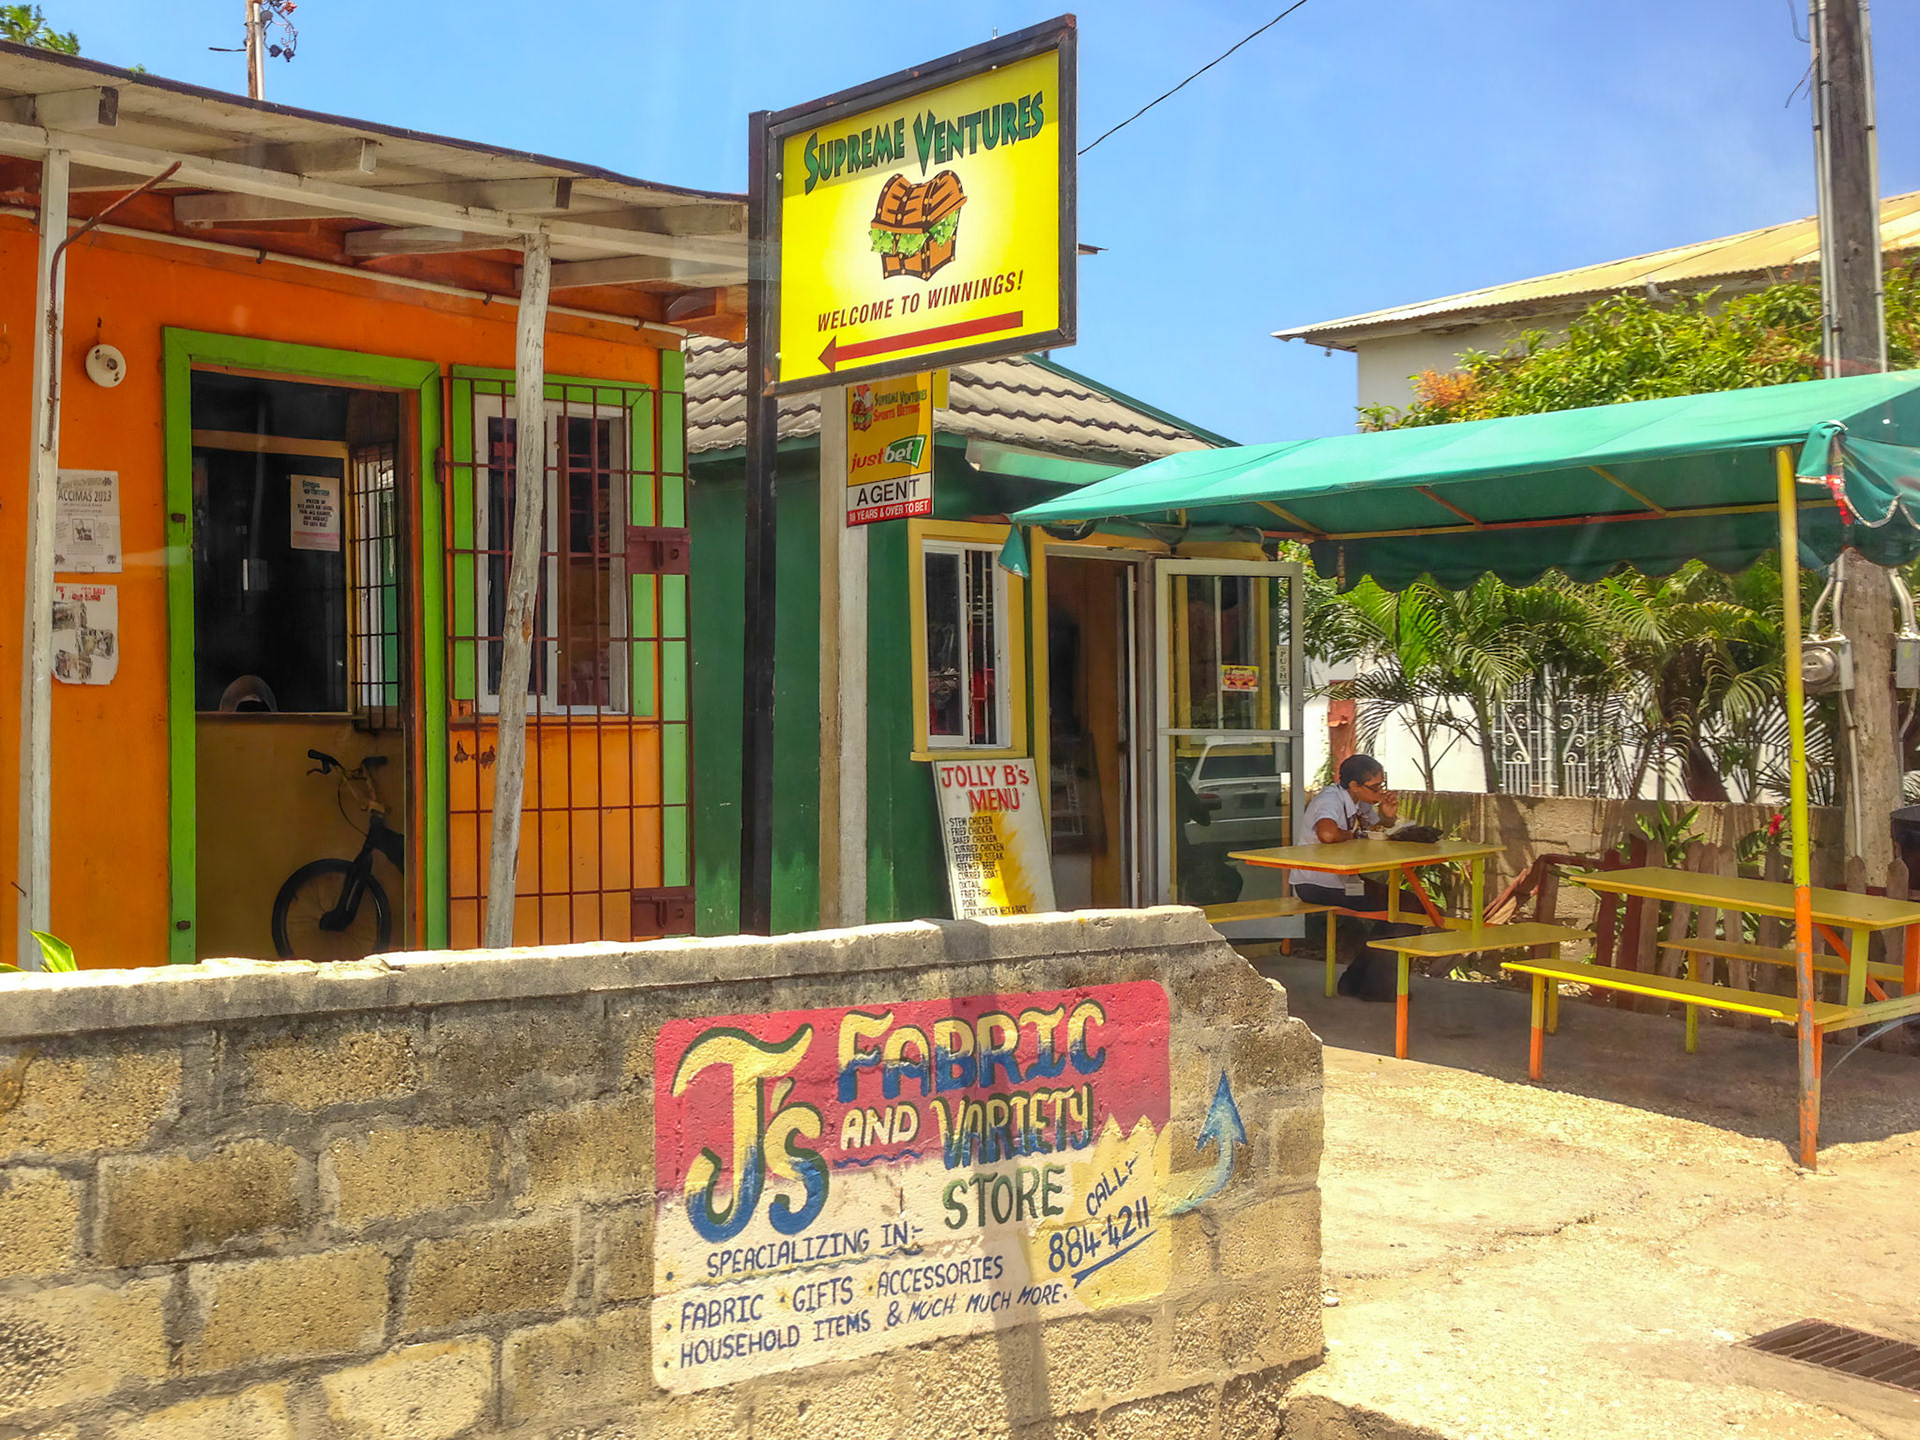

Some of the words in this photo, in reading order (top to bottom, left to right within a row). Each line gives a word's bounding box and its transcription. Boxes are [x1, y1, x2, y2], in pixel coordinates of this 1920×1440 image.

[803, 117, 905, 196] SUPREME
[912, 90, 1044, 177] VENTURES
[817, 298, 894, 332] WELCOME
[901, 293, 920, 316] TO
[927, 269, 1024, 309] WINNINGS!
[94, 489, 112, 502] 2013
[856, 478, 920, 507] AGENT
[857, 508, 878, 520] YEARS
[880, 507, 885, 518] &
[885, 504, 904, 517] OVER
[904, 502, 914, 514] TO
[915, 500, 929, 512] BET
[1279, 650, 1287, 679] PUSH
[941, 765, 996, 788] JOLLY
[967, 787, 1020, 812] MENU
[949, 817, 967, 827] STEW
[968, 816, 993, 826] CHICKEN
[951, 827, 966, 836] FRIED
[968, 825, 994, 835] CHICKEN
[952, 836, 970, 845] BAKED
[972, 834, 998, 844] CHICKEN
[954, 844, 978, 854] CURRIED
[980, 842, 1005, 852] CHICKEN
[956, 862, 980, 872] STEWED
[982, 861, 995, 870] BEEF
[984, 852, 1004, 861] STEAK
[959, 880, 980, 889] OXTAIL
[983, 870, 999, 879] GOAT
[961, 889, 976, 898] FRIED
[978, 889, 991, 898] FISH
[962, 899, 977, 908] PORK
[837, 998, 1107, 1104] FABRIC
[840, 1101, 921, 1150] AND
[929, 1081, 1094, 1171] VARIETY
[942, 1161, 1066, 1230] STORE
[1049, 1195, 1151, 1273] 884-4211
[706, 1228, 870, 1278] SPEACIALIZING
[680, 1293, 764, 1333] FABRIC
[792, 1275, 854, 1313] GIFTS
[877, 1255, 1004, 1299] ACCESSORIES
[680, 1324, 801, 1369] HOUSEHOLD
[813, 1309, 871, 1342] ITEMS
[886, 1300, 900, 1327] &
[906, 1292, 957, 1324] MUCH
[965, 1290, 1012, 1314] MUCH
